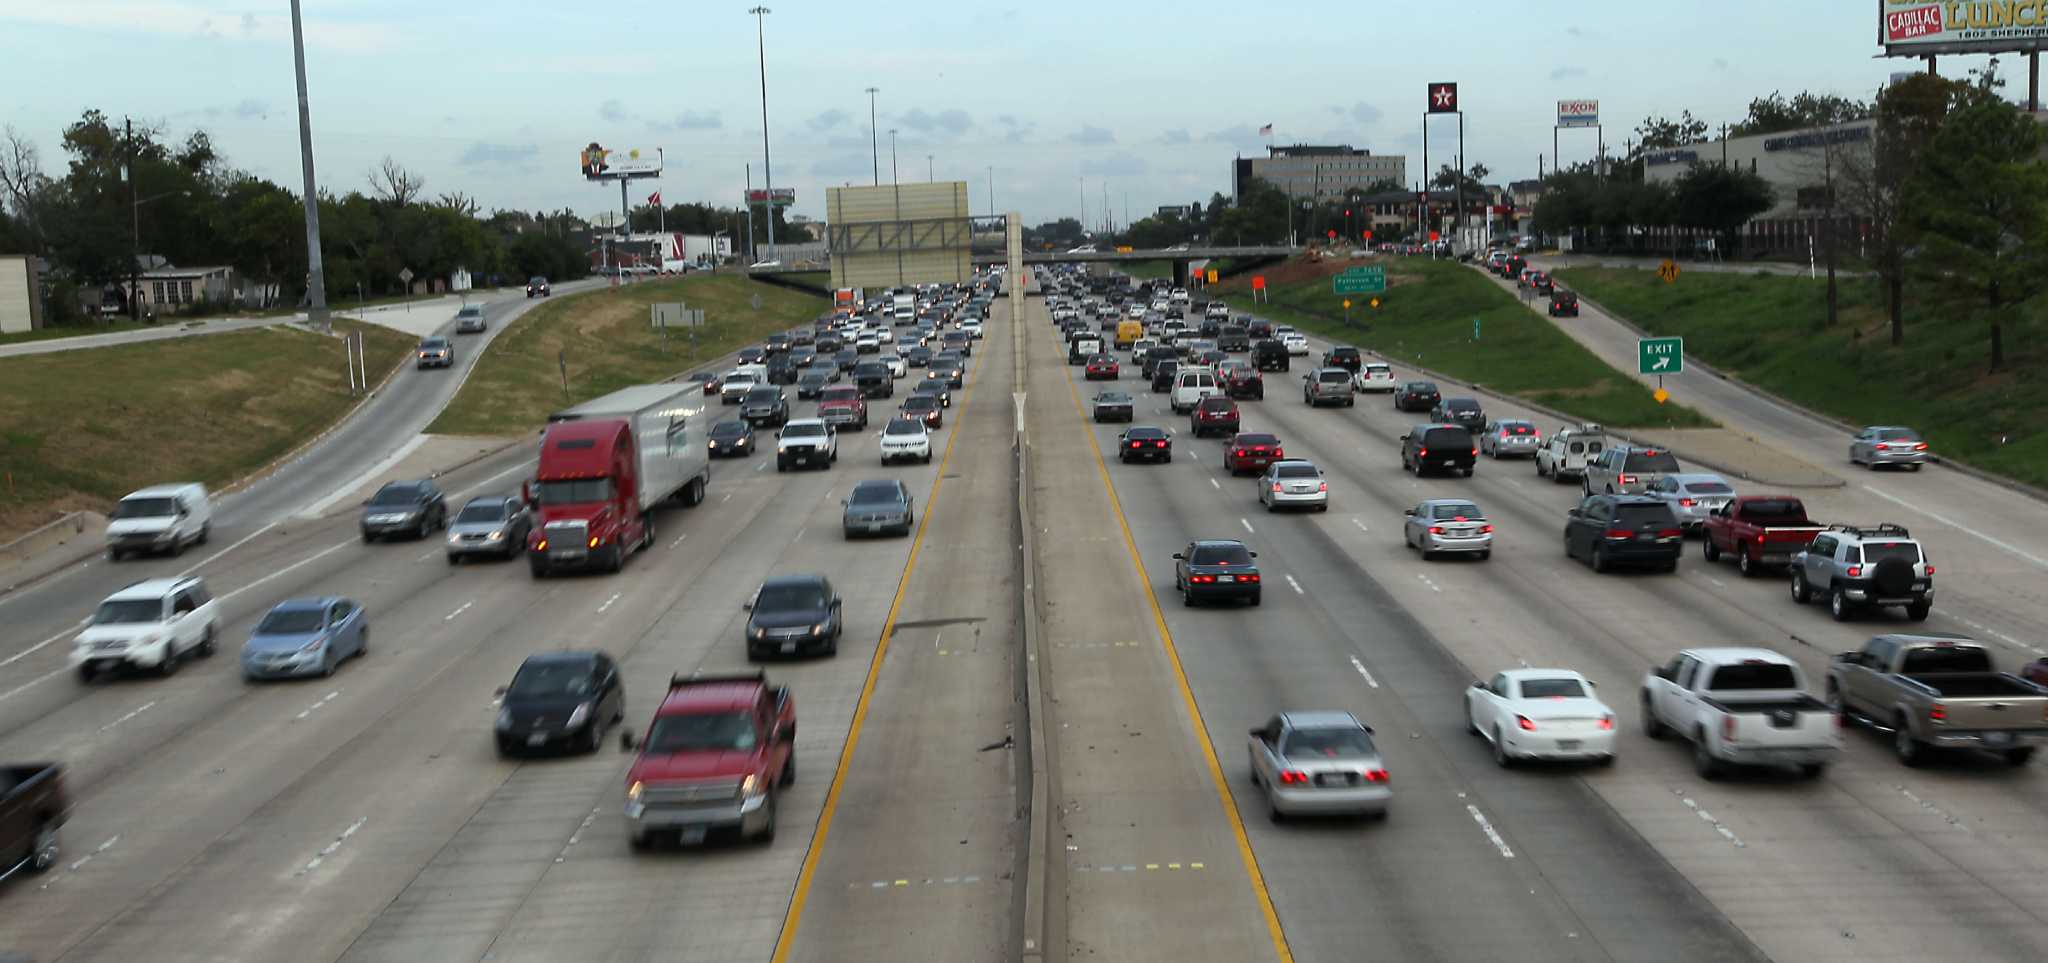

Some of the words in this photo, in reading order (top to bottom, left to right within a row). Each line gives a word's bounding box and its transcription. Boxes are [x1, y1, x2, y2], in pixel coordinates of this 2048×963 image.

[1889, 7, 1940, 32] CADILLAC
[1905, 25, 1927, 38] BAR
[1561, 102, 1596, 114] EXXON
[1647, 344, 1673, 355] EXIT
